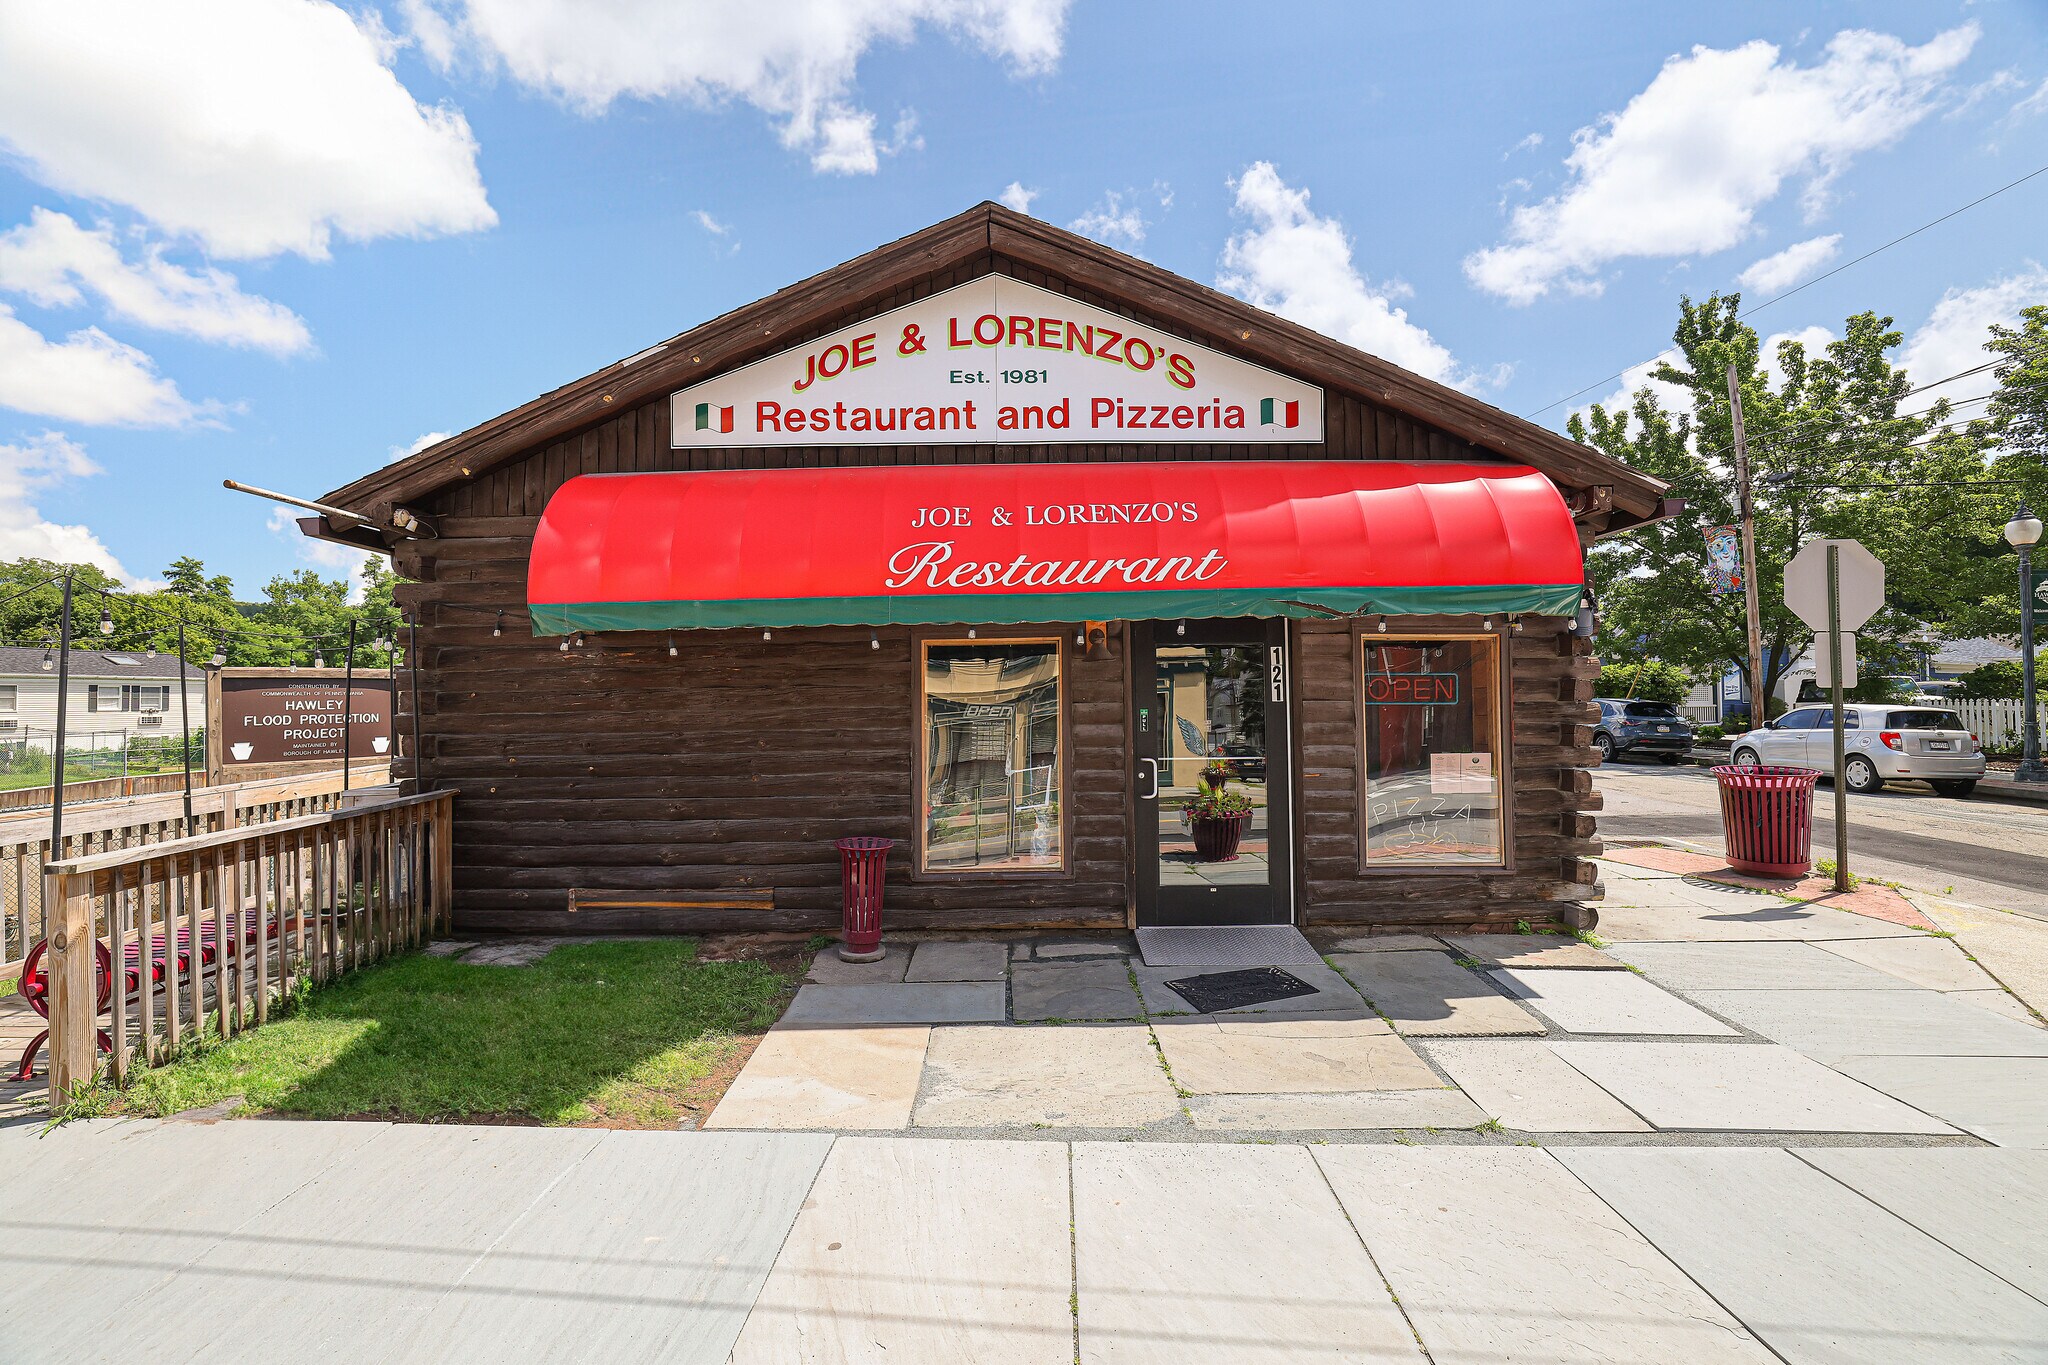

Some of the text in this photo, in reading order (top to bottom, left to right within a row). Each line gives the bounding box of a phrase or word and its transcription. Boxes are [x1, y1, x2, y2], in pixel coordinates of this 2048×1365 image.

[794, 313, 1198, 394] JOE & LORENZO'S
[949, 369, 1048, 384] Est. 1981
[755, 396, 1246, 433] Restaurant and Pizzeria
[911, 502, 1199, 529] JOE & LORENZO'S
[884, 540, 1229, 588] Restaurant
[1272, 647, 1282, 701] 121
[1368, 678, 1453, 701] OPEN
[285, 700, 344, 711] HAWLEY
[966, 706, 1013, 717] OPEN
[244, 713, 380, 727] FLOOD PROTECTION
[283, 728, 346, 740] PROJECT
[283, 749, 312, 757] BOROUGH
[1372, 796, 1471, 825] PIZZA
